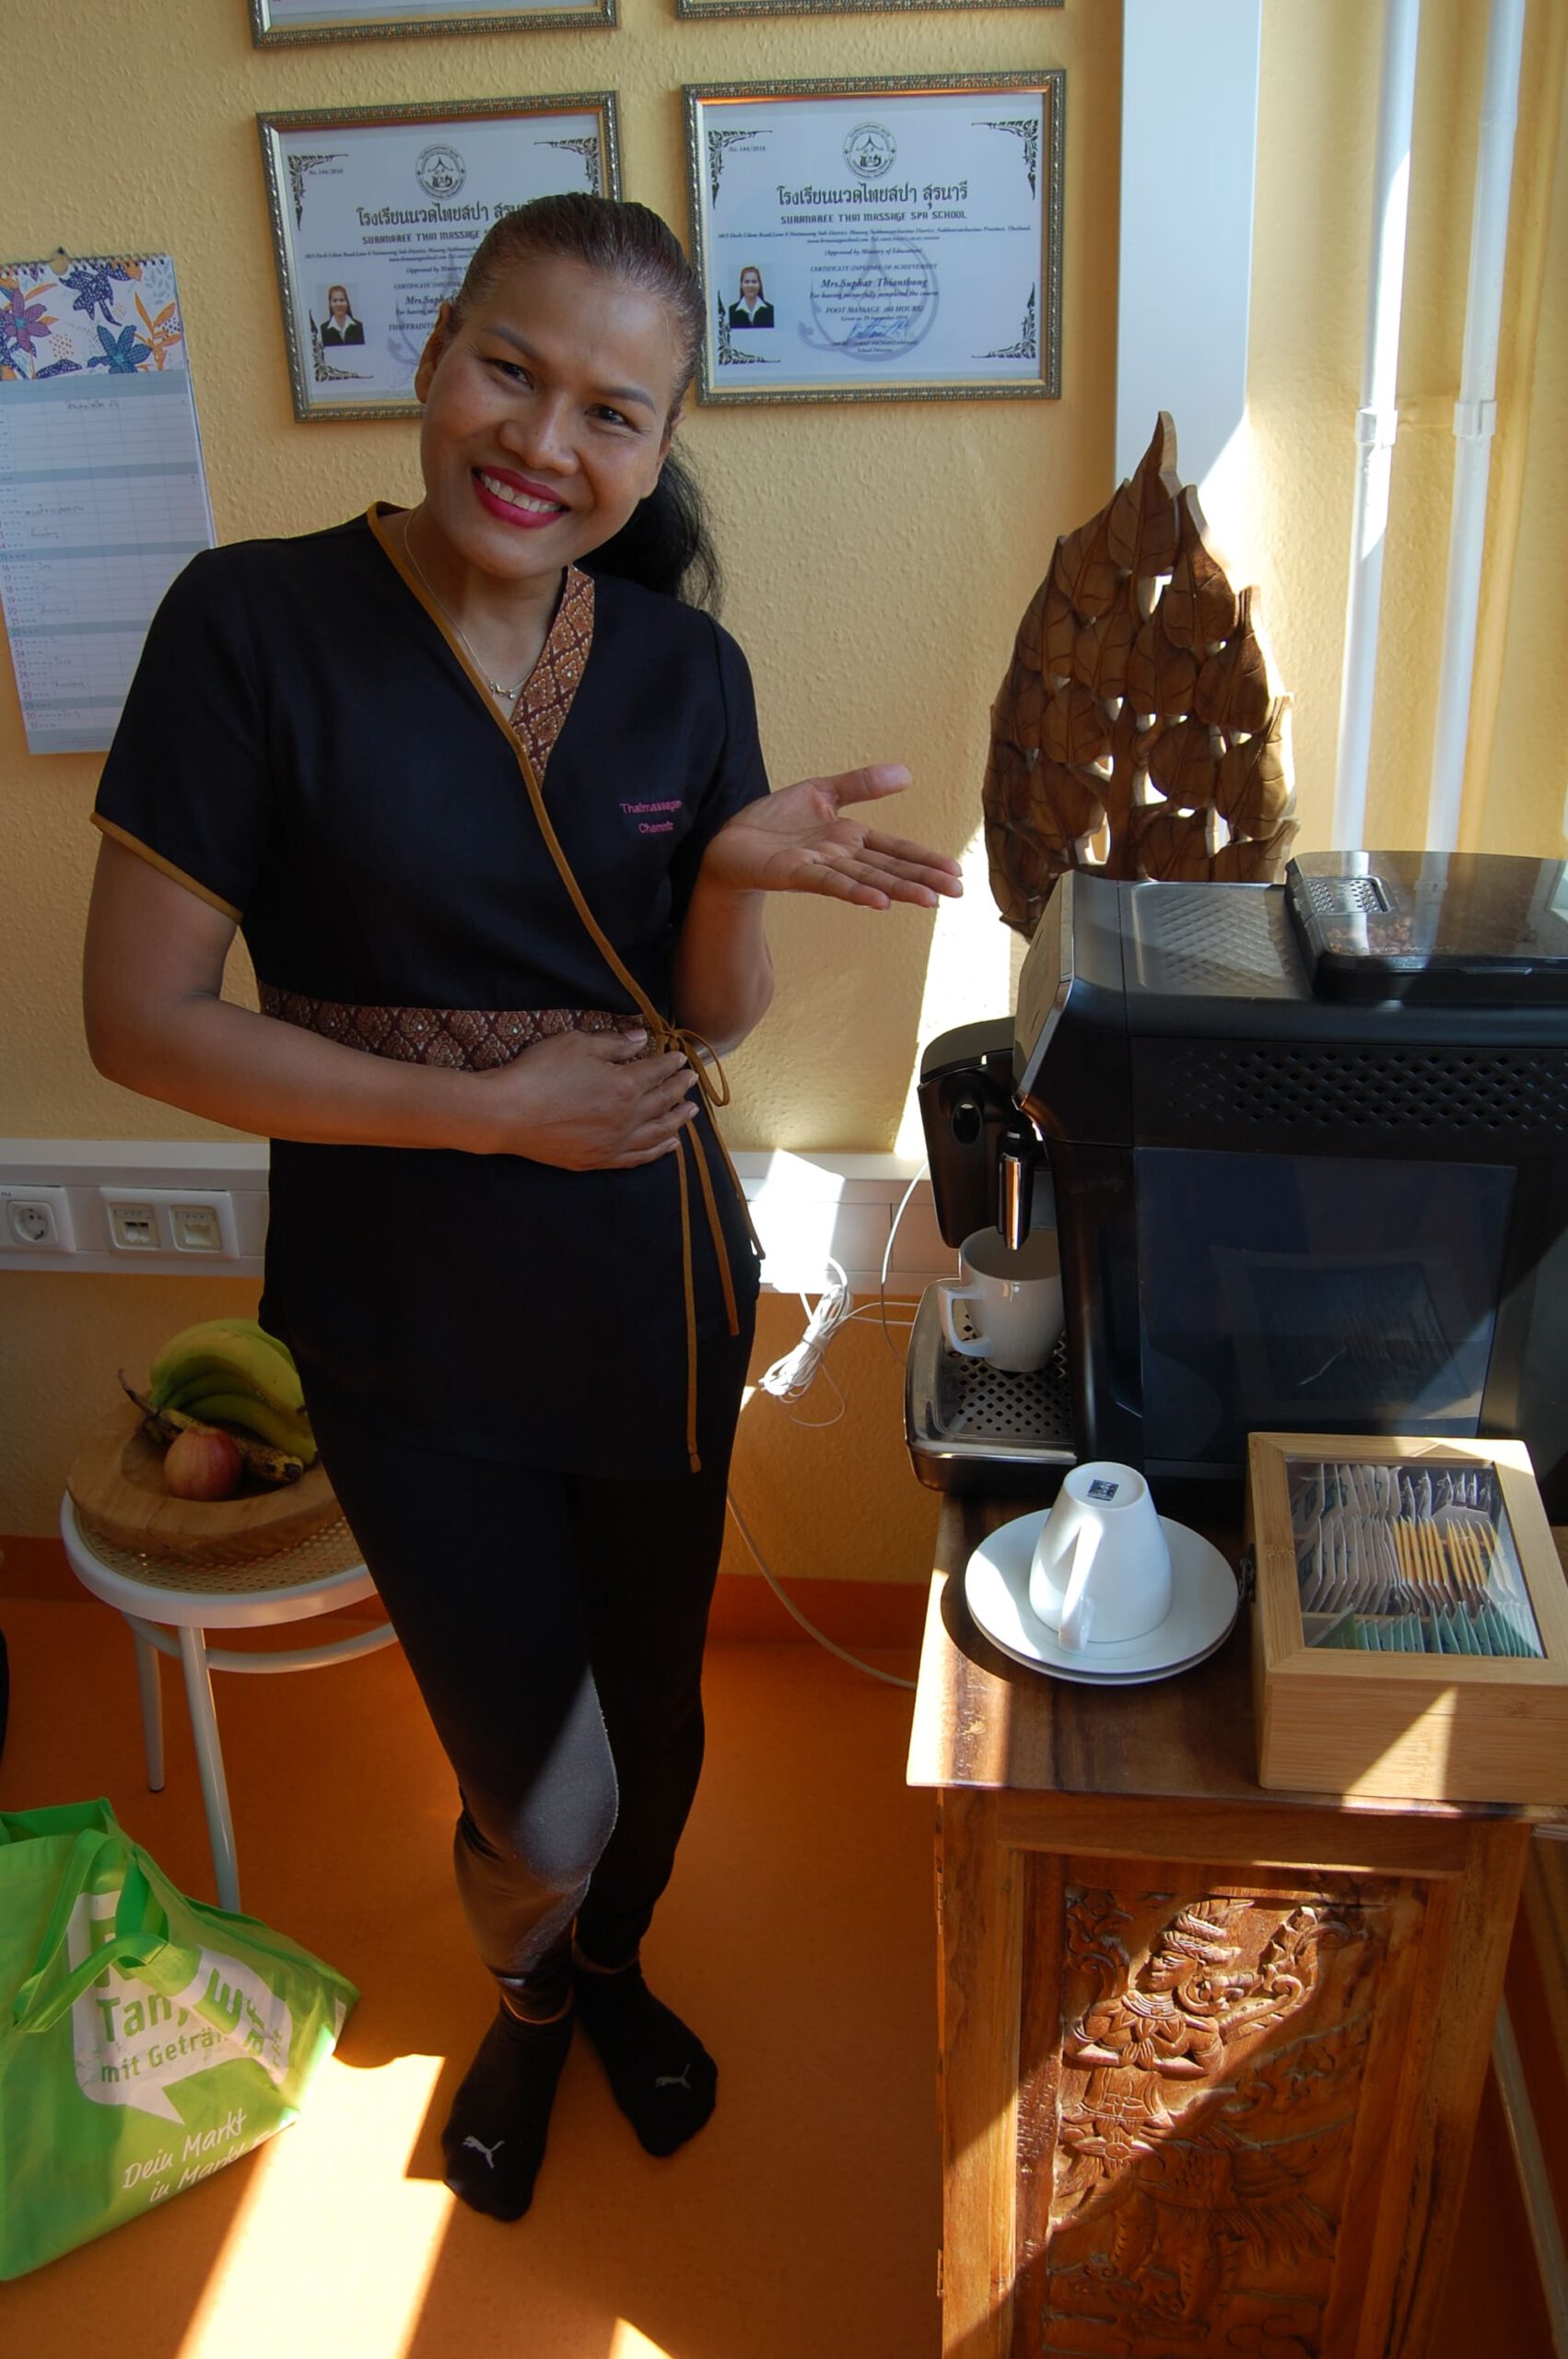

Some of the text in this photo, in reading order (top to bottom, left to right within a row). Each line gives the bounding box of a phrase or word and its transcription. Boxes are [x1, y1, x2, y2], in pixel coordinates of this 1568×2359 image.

[839, 213, 860, 223] THAI
[864, 212, 907, 222] MASSAGE
[910, 211, 929, 220] SPA
[931, 210, 967, 220] SCHOOL
[440, 230, 479, 241] MASSAGE
[100, 2055, 141, 2083] mit
[123, 2148, 174, 2189] Dein
[182, 2107, 248, 2162] Markt
[148, 2180, 170, 2203] in
